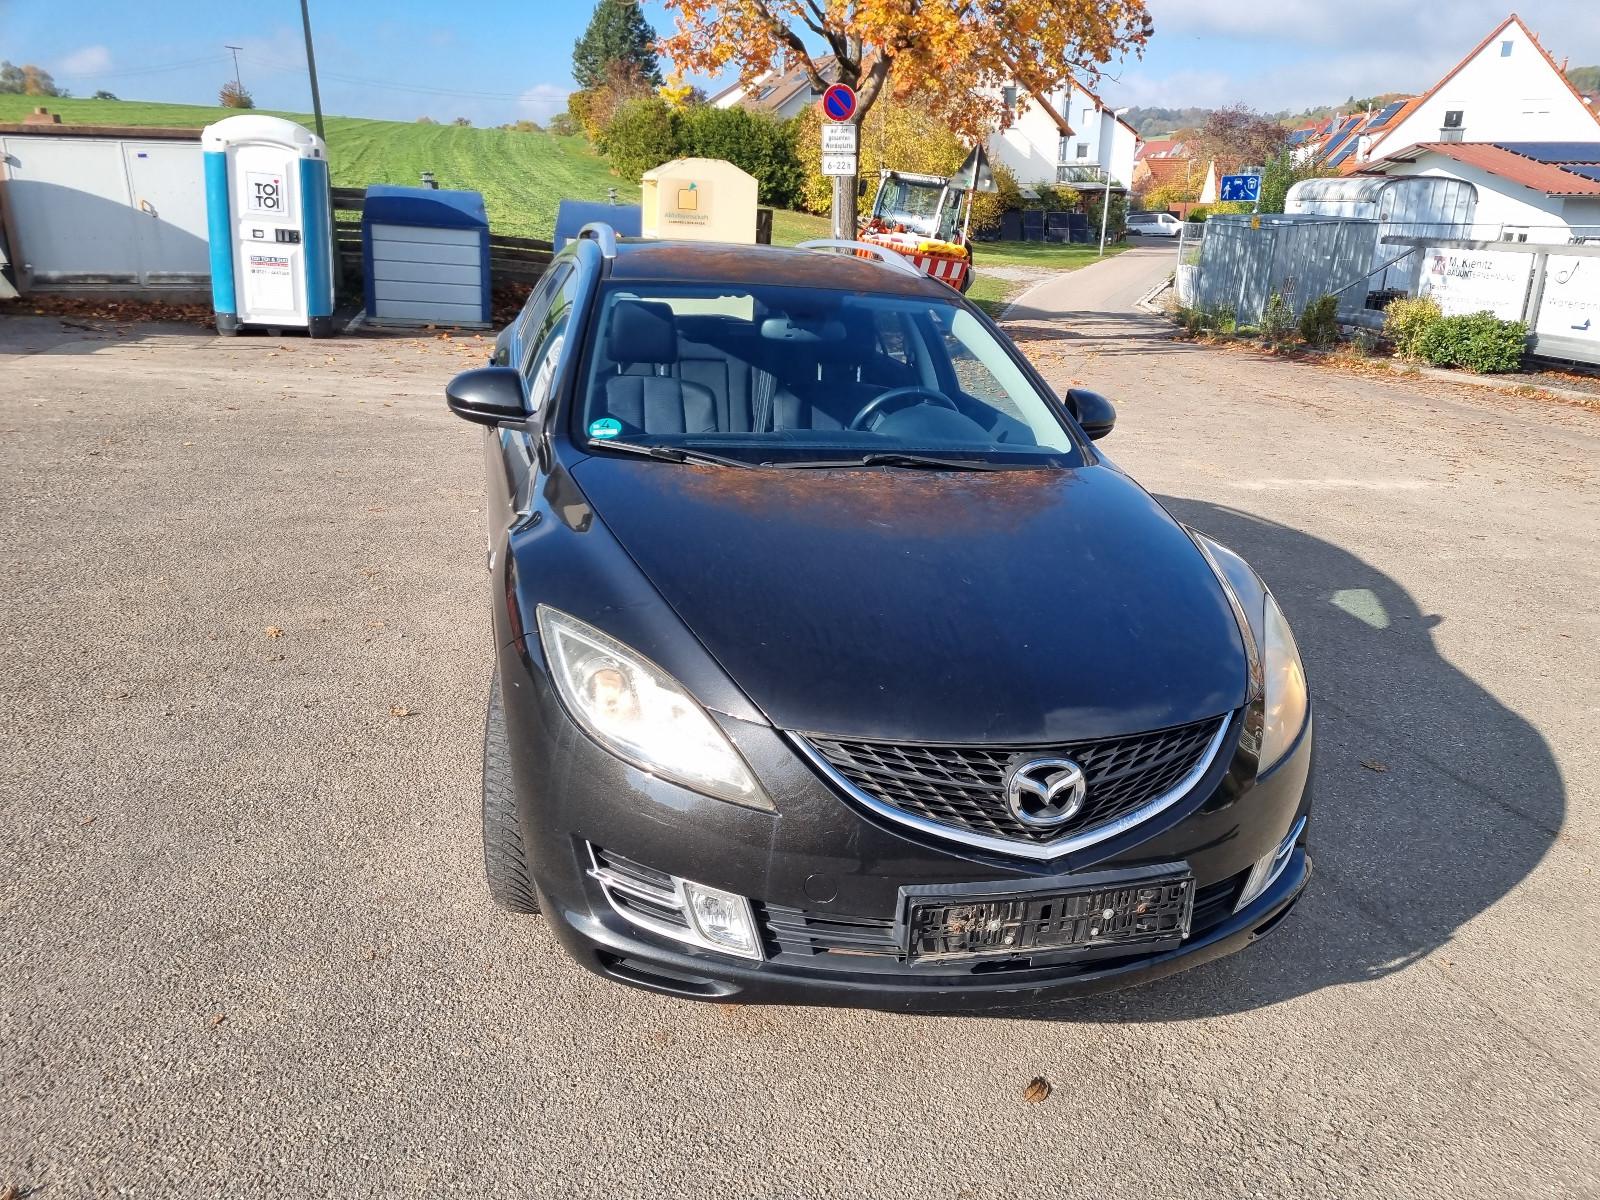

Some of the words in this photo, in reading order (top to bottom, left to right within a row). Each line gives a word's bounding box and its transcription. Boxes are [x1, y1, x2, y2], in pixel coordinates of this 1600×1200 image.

[254, 180, 279, 197] TOI
[255, 196, 280, 209] TOI
[1461, 258, 1493, 270] Kienitz
[601, 419, 611, 428] 4
